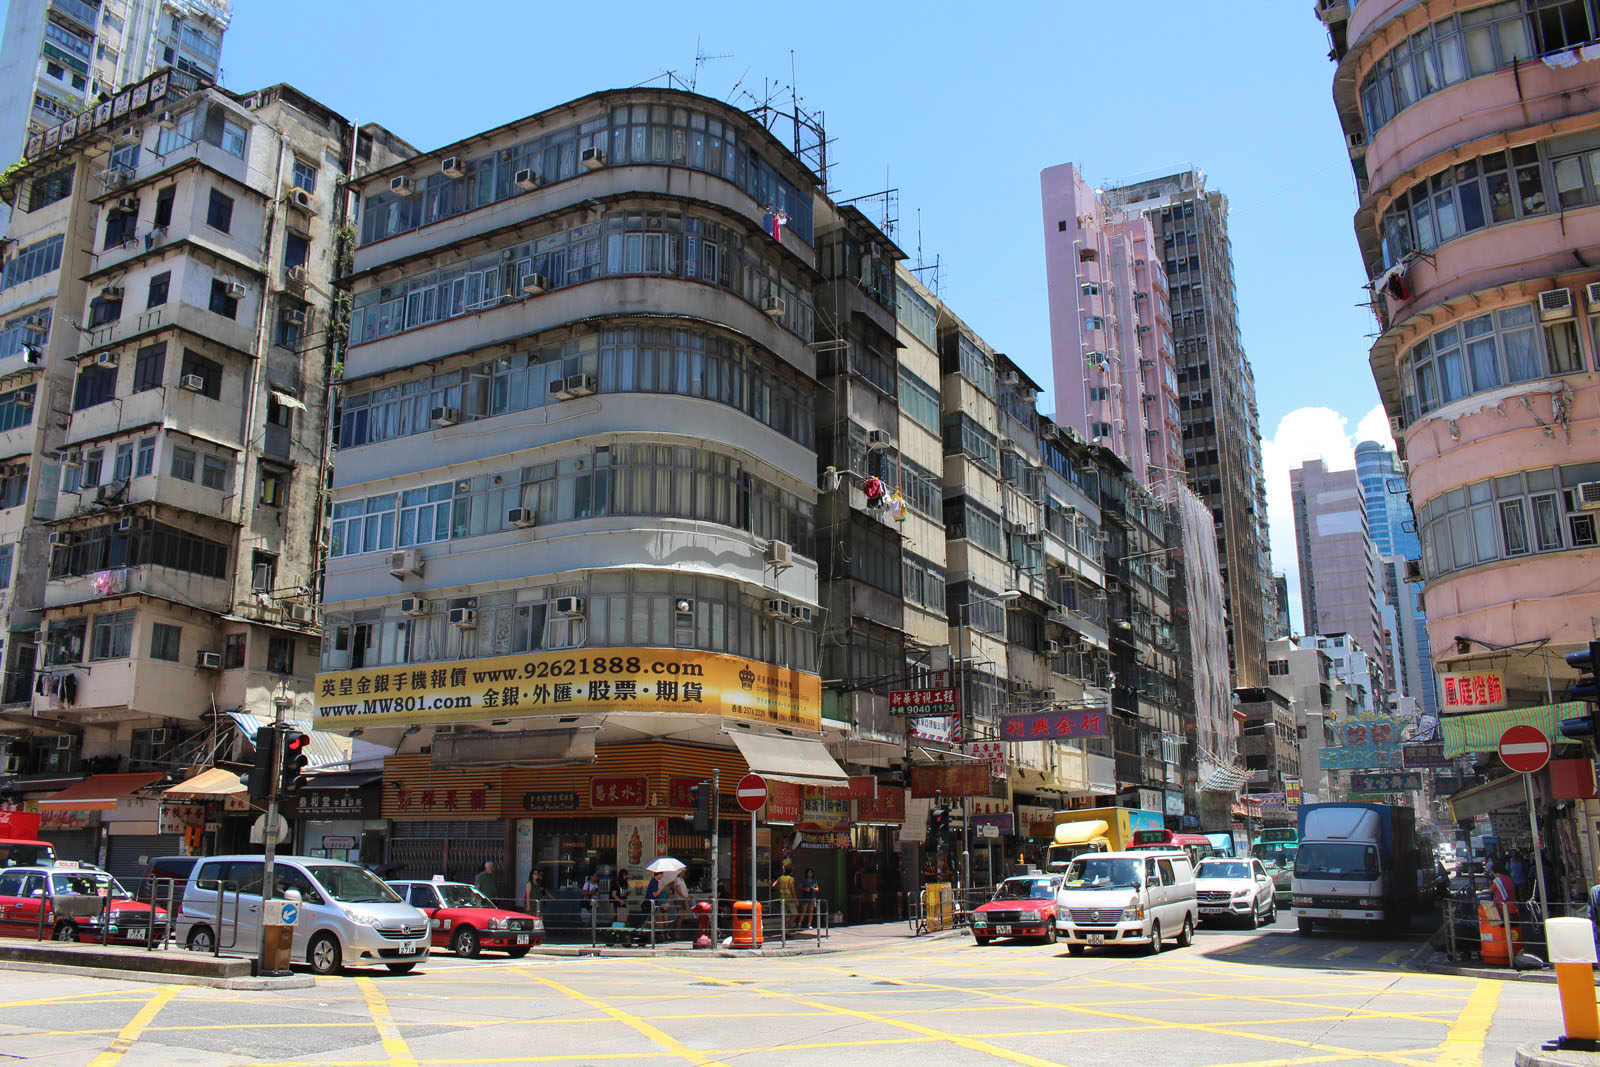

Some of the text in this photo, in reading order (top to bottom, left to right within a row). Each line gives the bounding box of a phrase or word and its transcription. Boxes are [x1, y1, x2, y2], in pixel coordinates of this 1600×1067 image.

[321, 656, 704, 698] 英皇金銀手機報價 www.92621888.com
[320, 695, 472, 717] www.MW801.com
[907, 704, 931, 714] 9040
[933, 703, 955, 713] 1124
[1005, 714, 1102, 737] 利興金行
